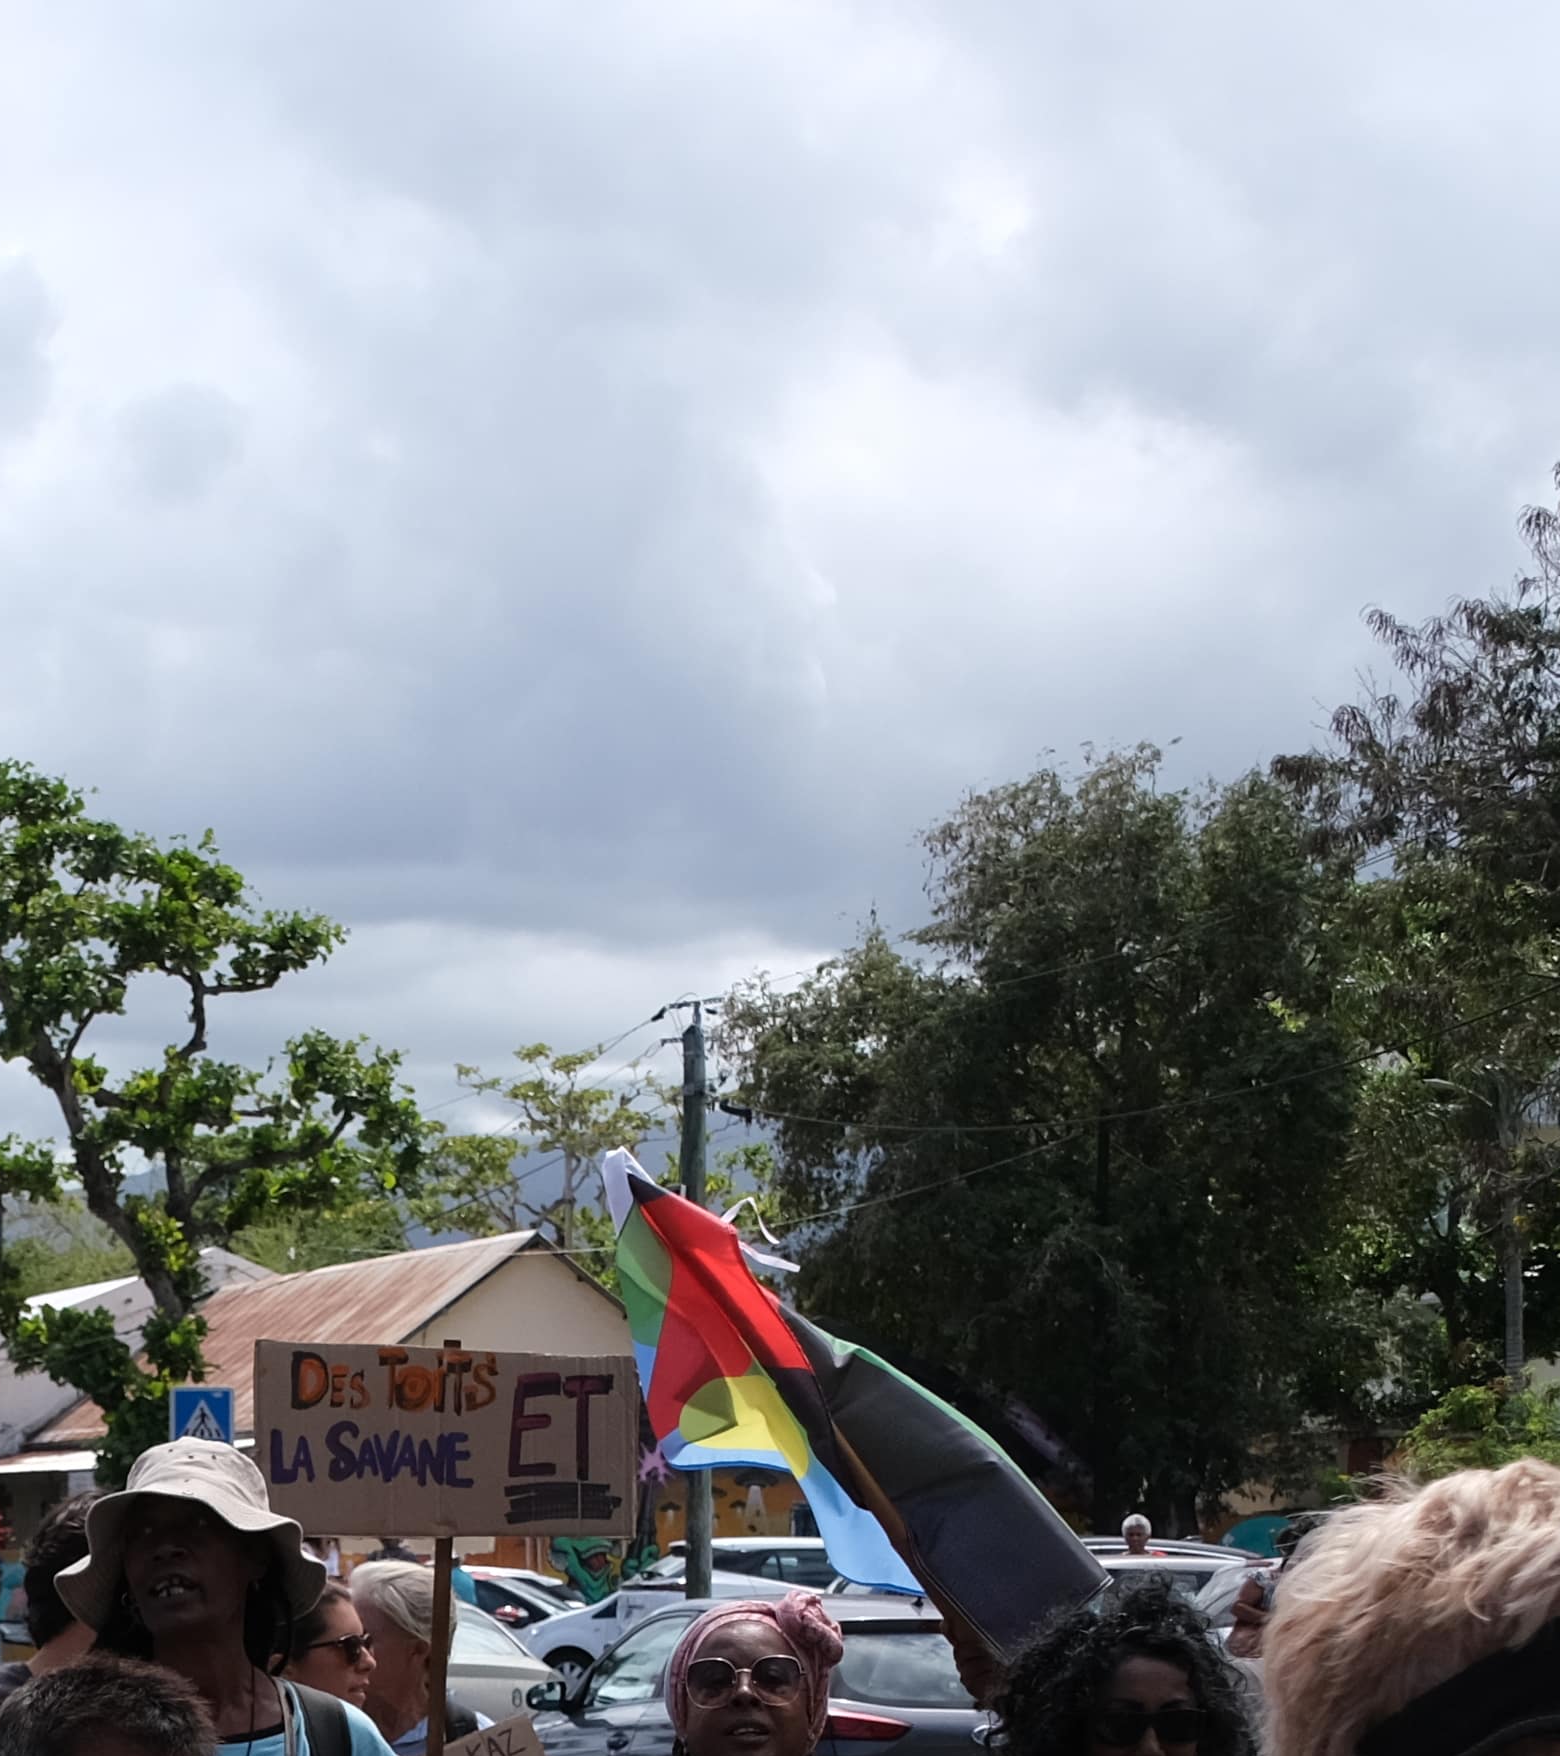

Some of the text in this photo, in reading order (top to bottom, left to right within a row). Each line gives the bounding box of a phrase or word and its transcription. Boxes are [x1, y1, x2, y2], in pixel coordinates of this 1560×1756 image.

[270, 1420, 475, 1489] LA SAVANE
[508, 1372, 615, 1482] ET
